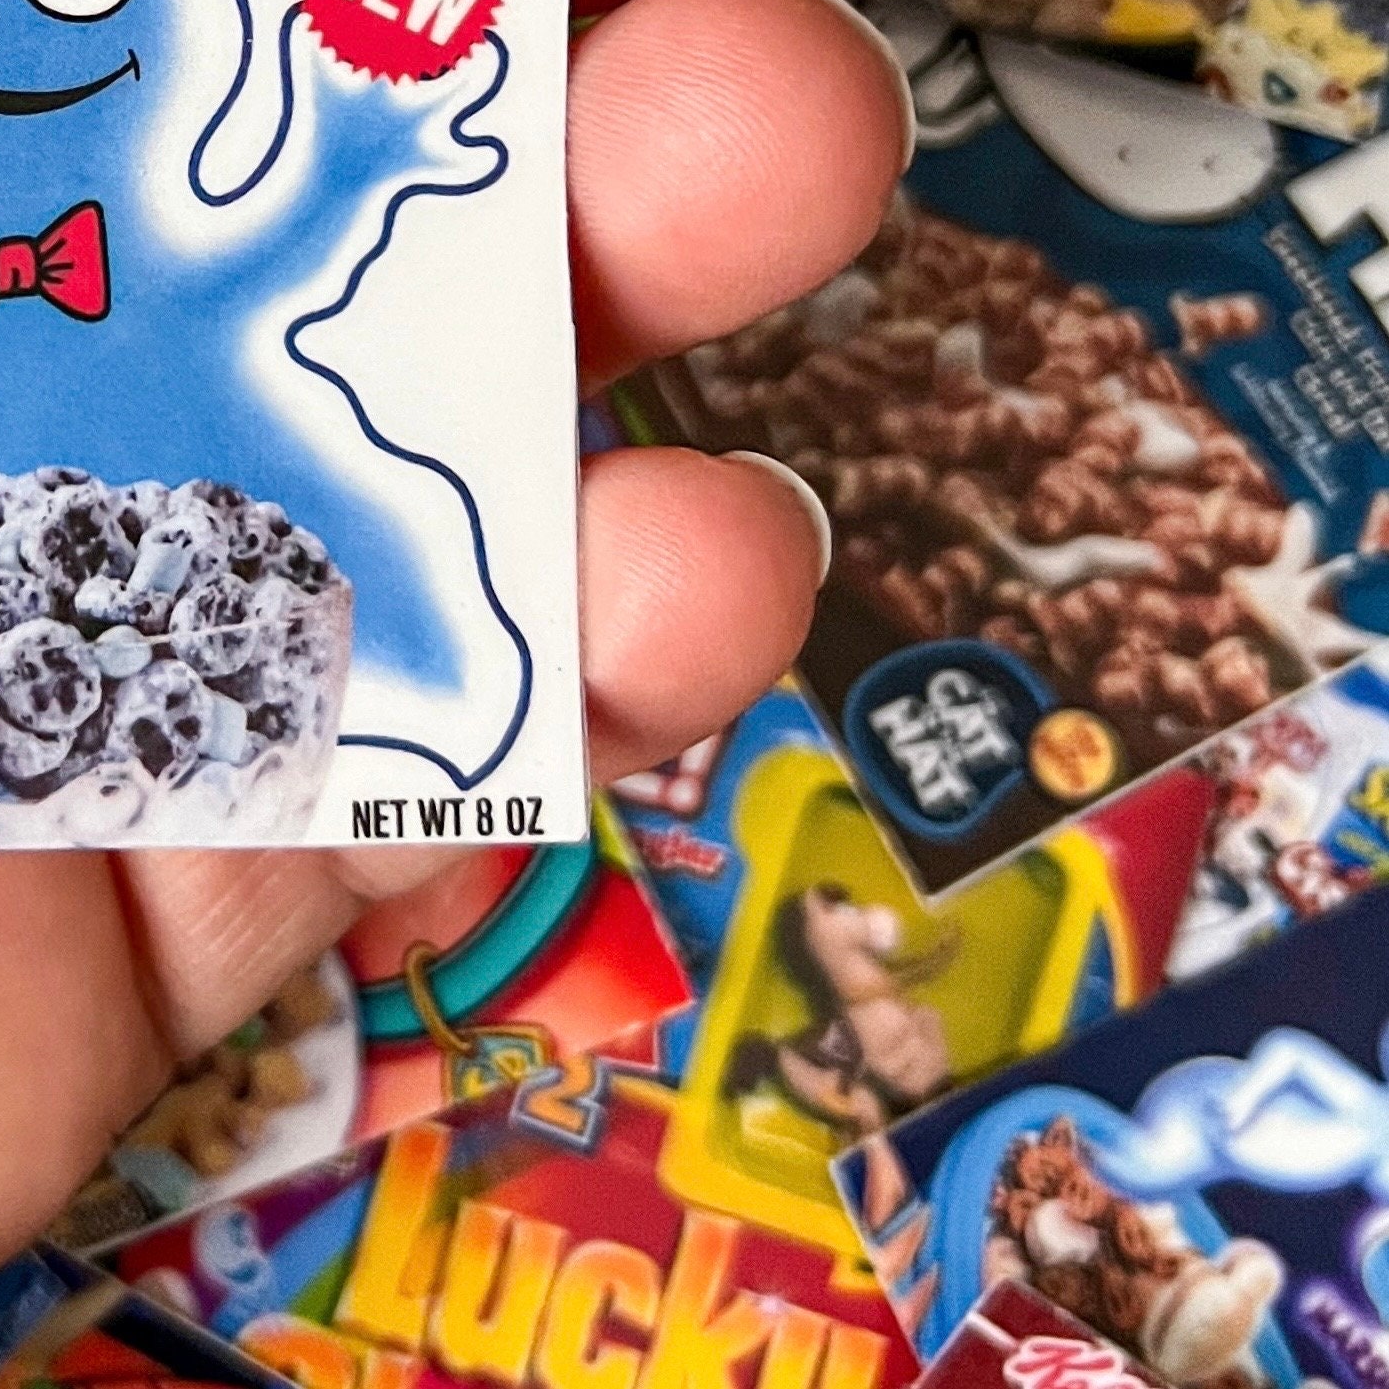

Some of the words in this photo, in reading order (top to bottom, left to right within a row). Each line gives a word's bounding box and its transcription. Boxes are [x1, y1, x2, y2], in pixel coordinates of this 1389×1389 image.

[868, 695, 974, 812] HAT
[926, 668, 1012, 762] CAT
[351, 799, 410, 839] NET
[418, 798, 466, 838] WT
[476, 797, 494, 836] 8
[504, 796, 545, 837] OZ
